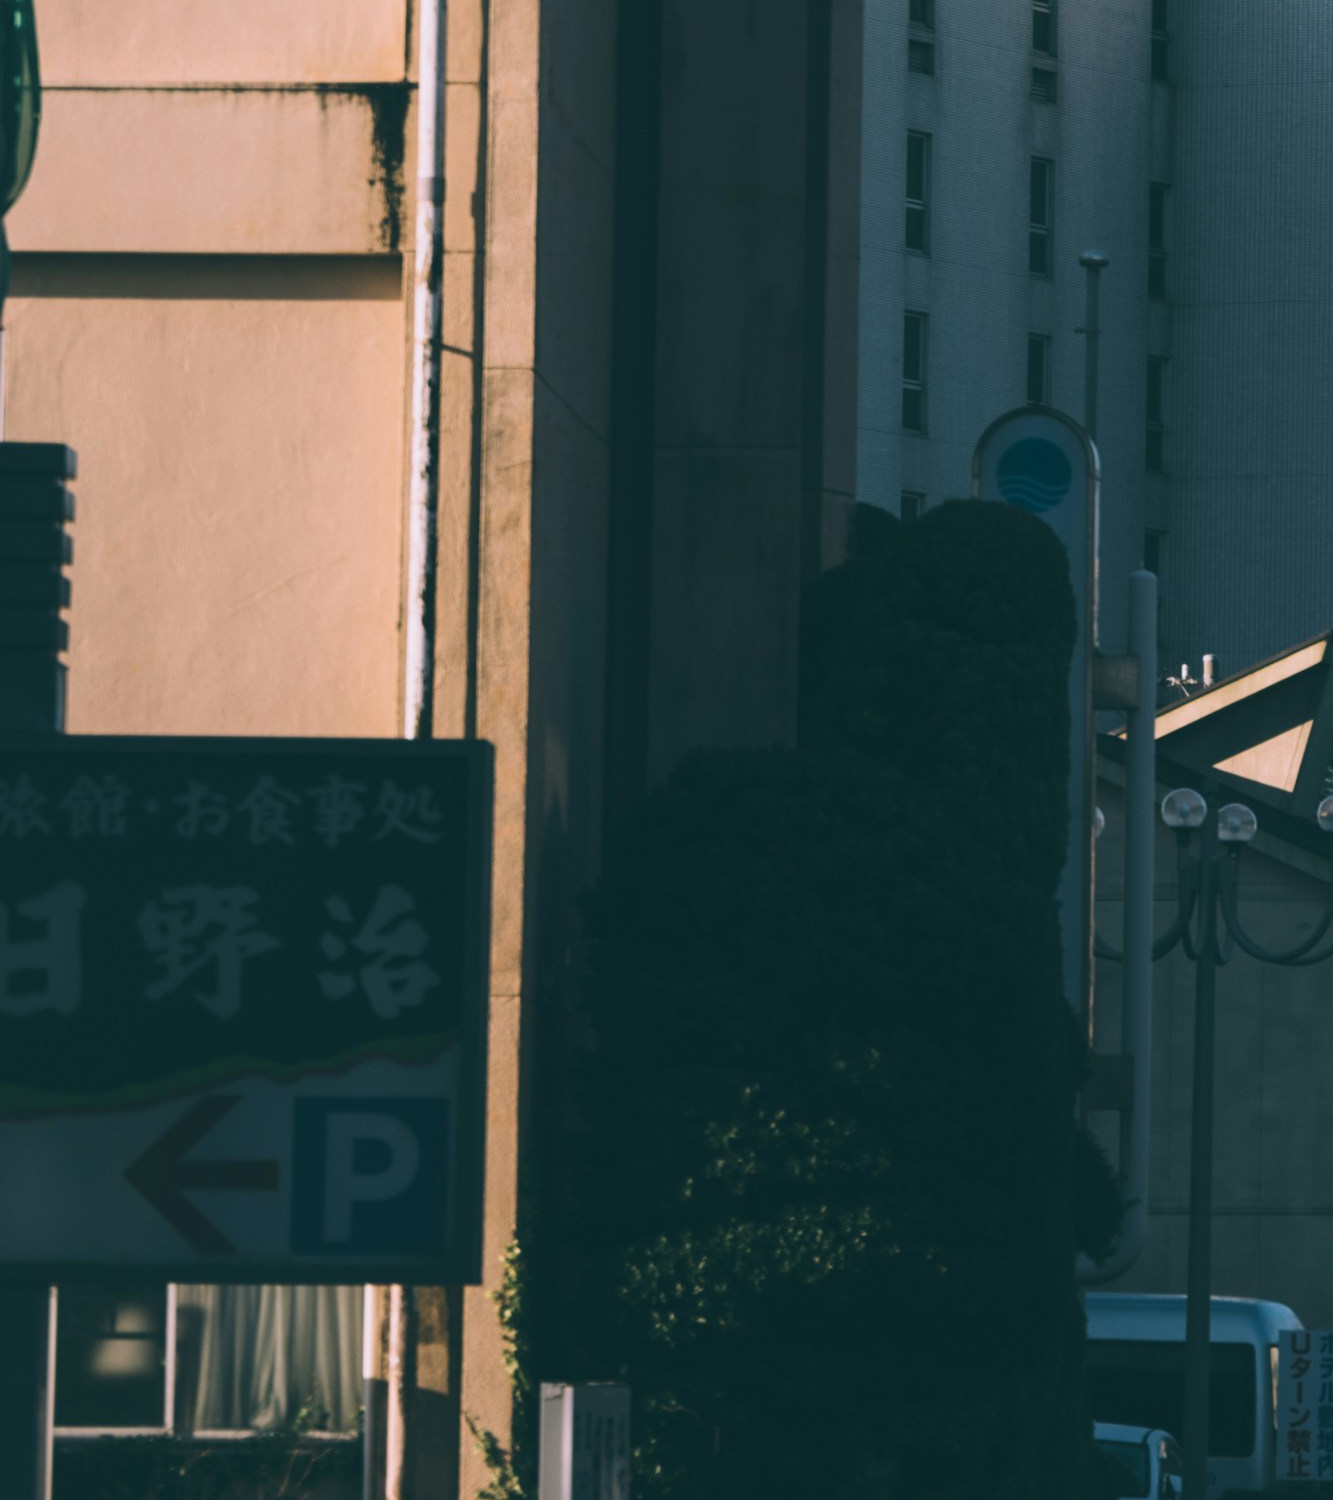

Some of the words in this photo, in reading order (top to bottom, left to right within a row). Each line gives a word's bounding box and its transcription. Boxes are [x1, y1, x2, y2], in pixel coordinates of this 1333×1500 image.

[0, 876, 441, 1022] 日野治
[324, 1112, 420, 1243] P
[1286, 1332, 1312, 1478] Uターン禁止
